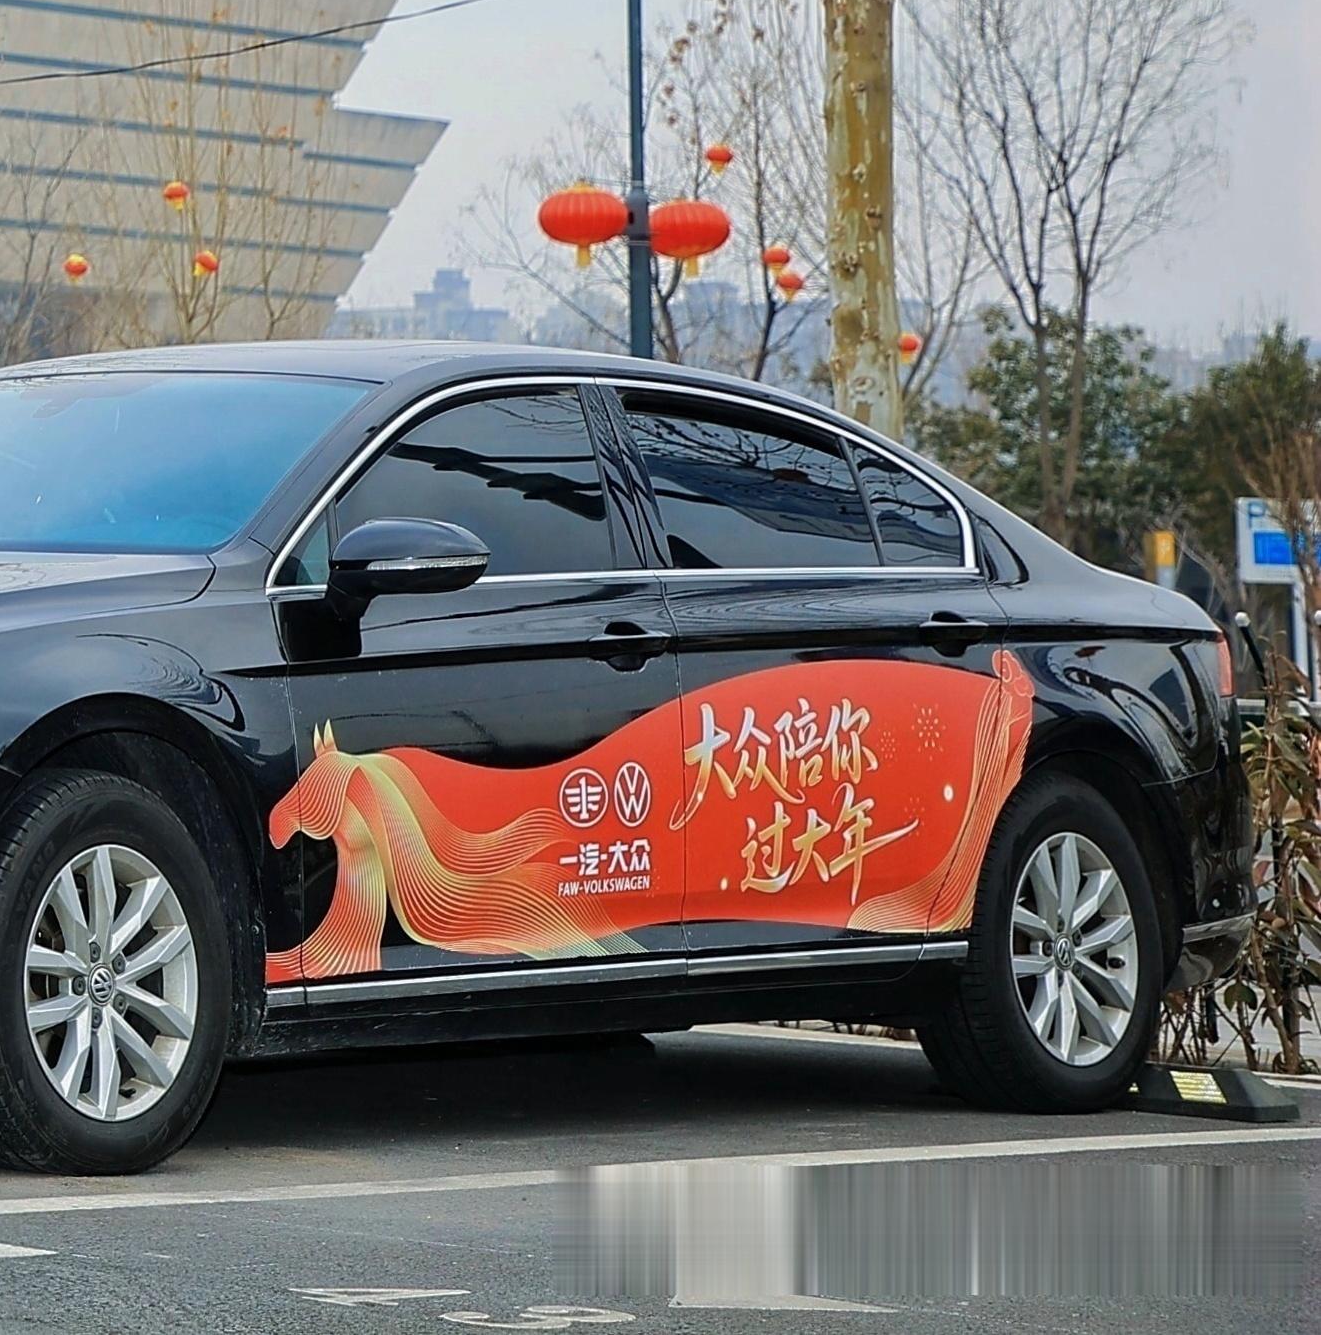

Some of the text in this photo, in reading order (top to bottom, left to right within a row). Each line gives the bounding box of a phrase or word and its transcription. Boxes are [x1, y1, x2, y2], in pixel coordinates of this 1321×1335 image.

[669, 697, 879, 831] 大众陪你
[558, 875, 651, 898] FAW-VOLKSWAGEN
[740, 782, 919, 906] 过大年
